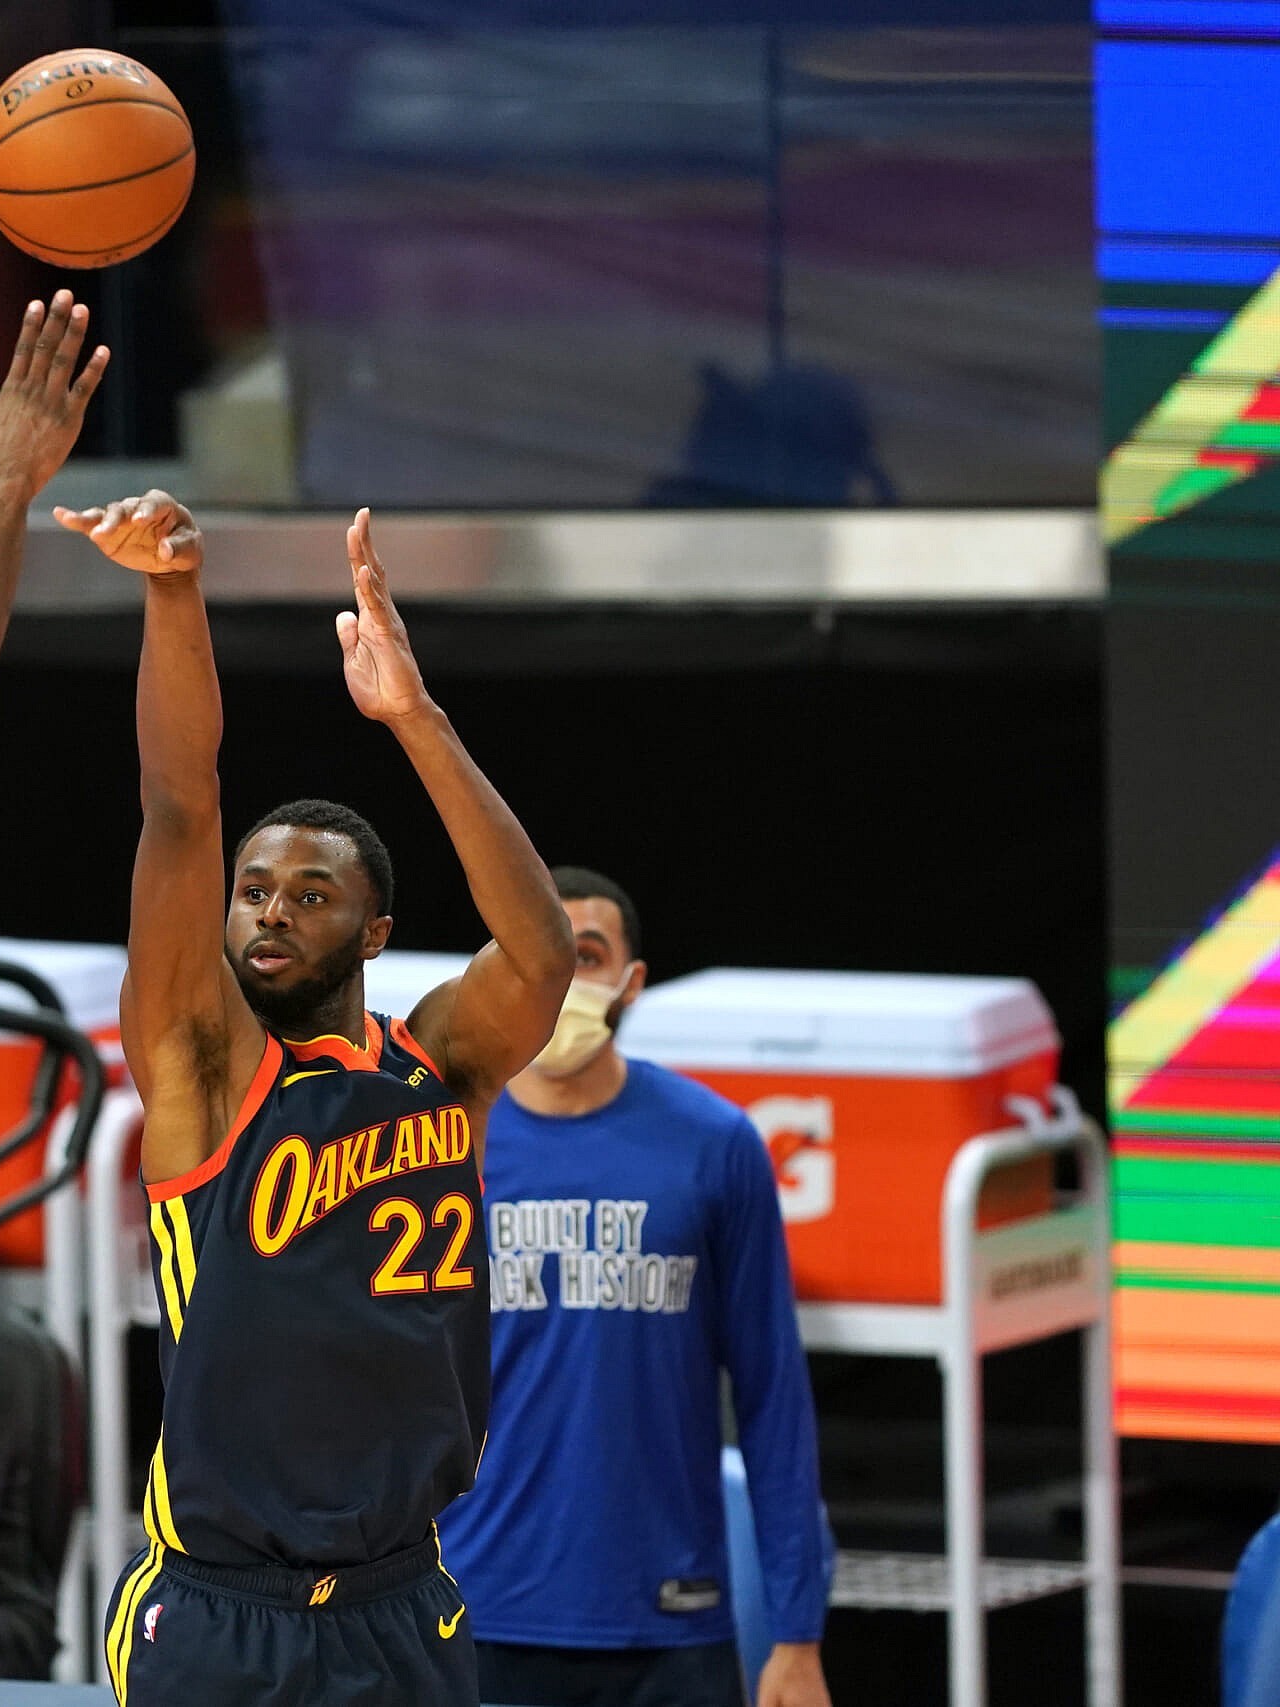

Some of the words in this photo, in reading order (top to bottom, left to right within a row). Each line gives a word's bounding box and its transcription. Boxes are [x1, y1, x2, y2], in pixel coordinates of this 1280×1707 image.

[249, 1103, 473, 1258] OAKLAND
[746, 1094, 836, 1223] G
[368, 1191, 474, 1296] 22
[490, 1201, 590, 1254] BUILT
[594, 1201, 648, 1254] BY
[558, 1252, 698, 1314] HISTORY
